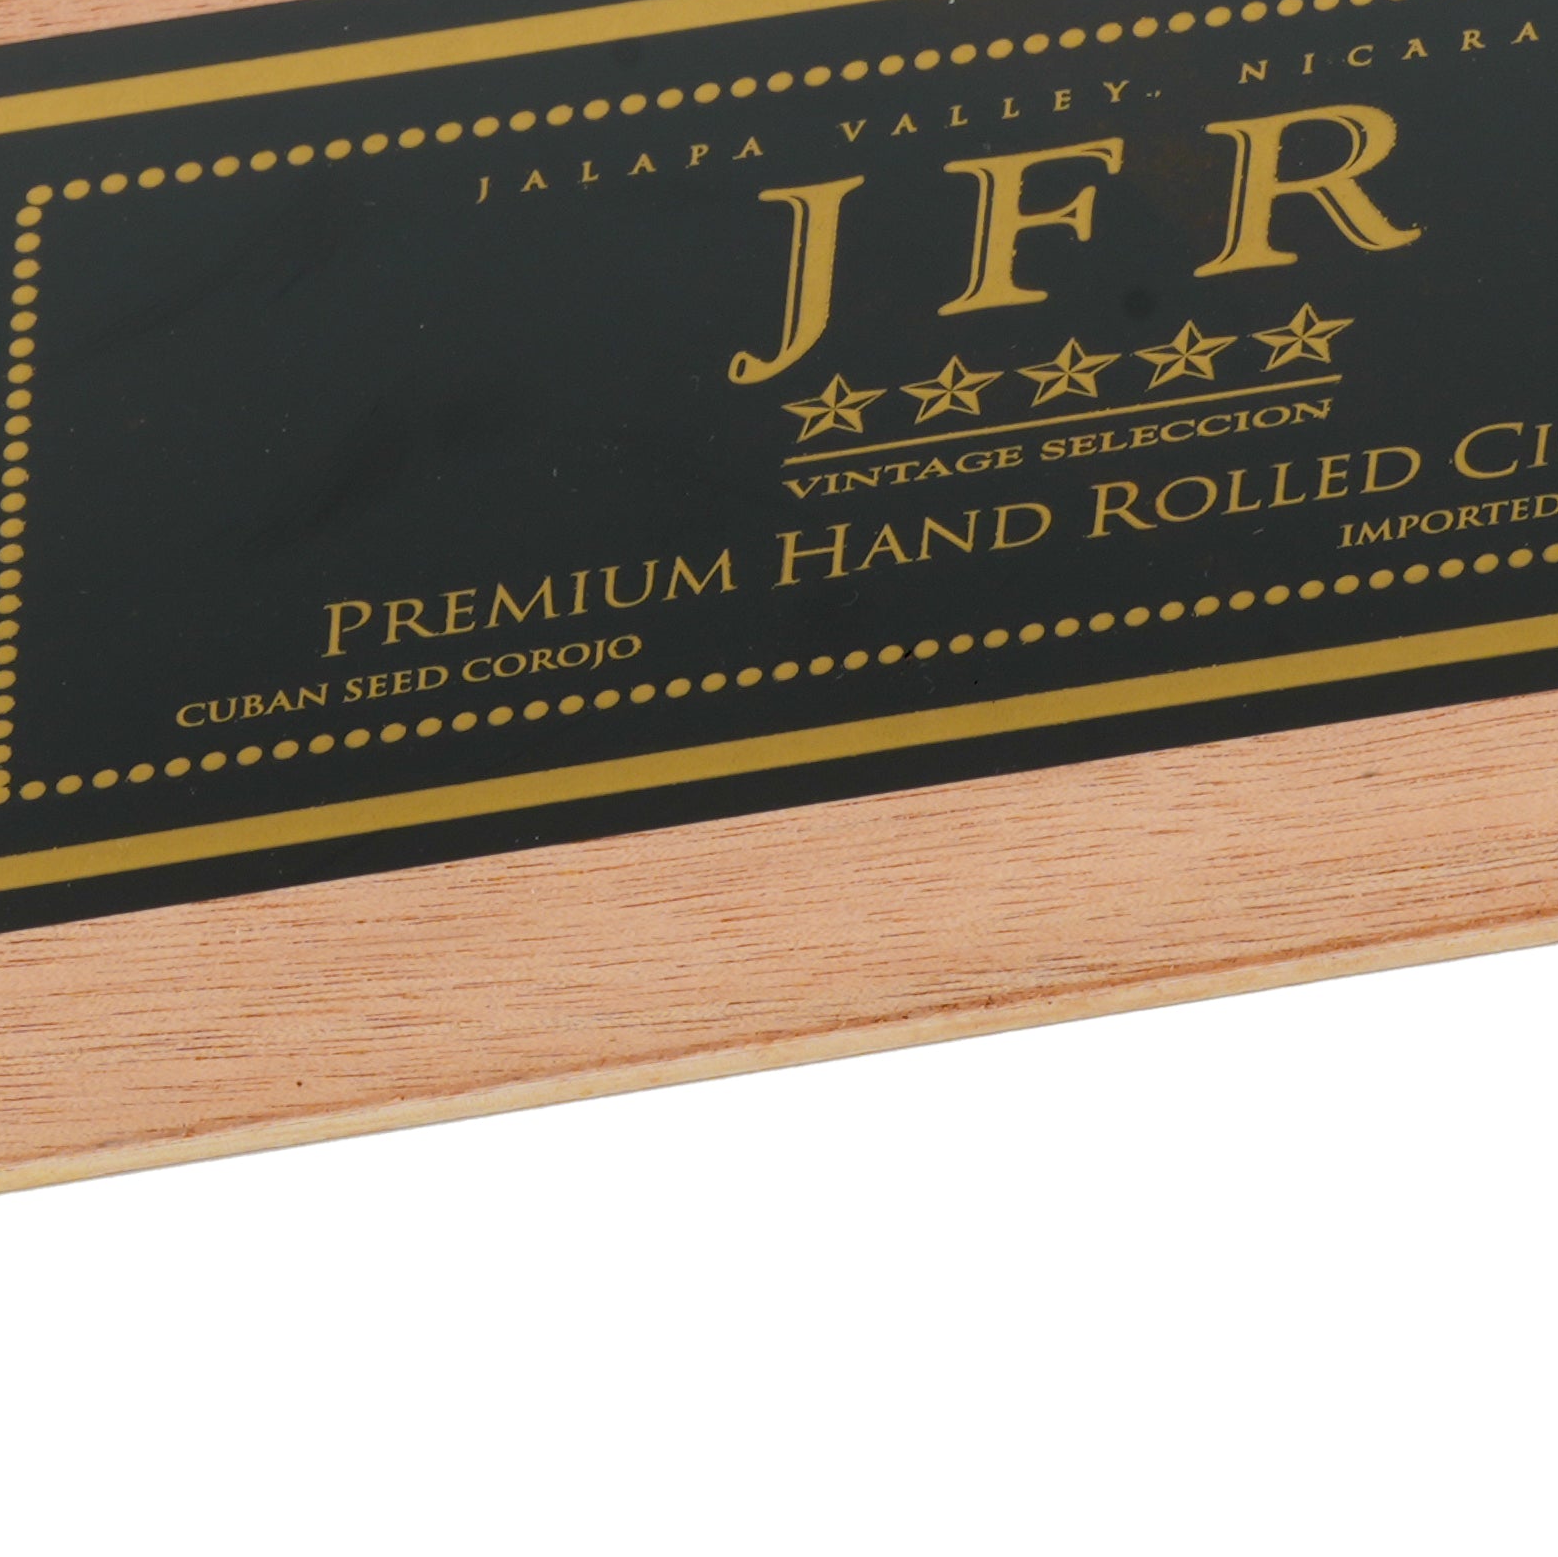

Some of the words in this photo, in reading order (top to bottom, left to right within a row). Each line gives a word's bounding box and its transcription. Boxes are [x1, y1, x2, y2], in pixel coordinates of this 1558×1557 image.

[475, 136, 765, 204] JALAPA
[726, 102, 1424, 386] JFR
[783, 445, 1024, 500] VINTAGE
[1040, 397, 1335, 462] SELECCION
[320, 548, 739, 659] PREMIUM
[771, 502, 1053, 589] HAND
[1086, 445, 1423, 541] ROLLED
[173, 682, 330, 729] CUBAN
[342, 664, 449, 704] SEED
[459, 633, 645, 685] COROJO
